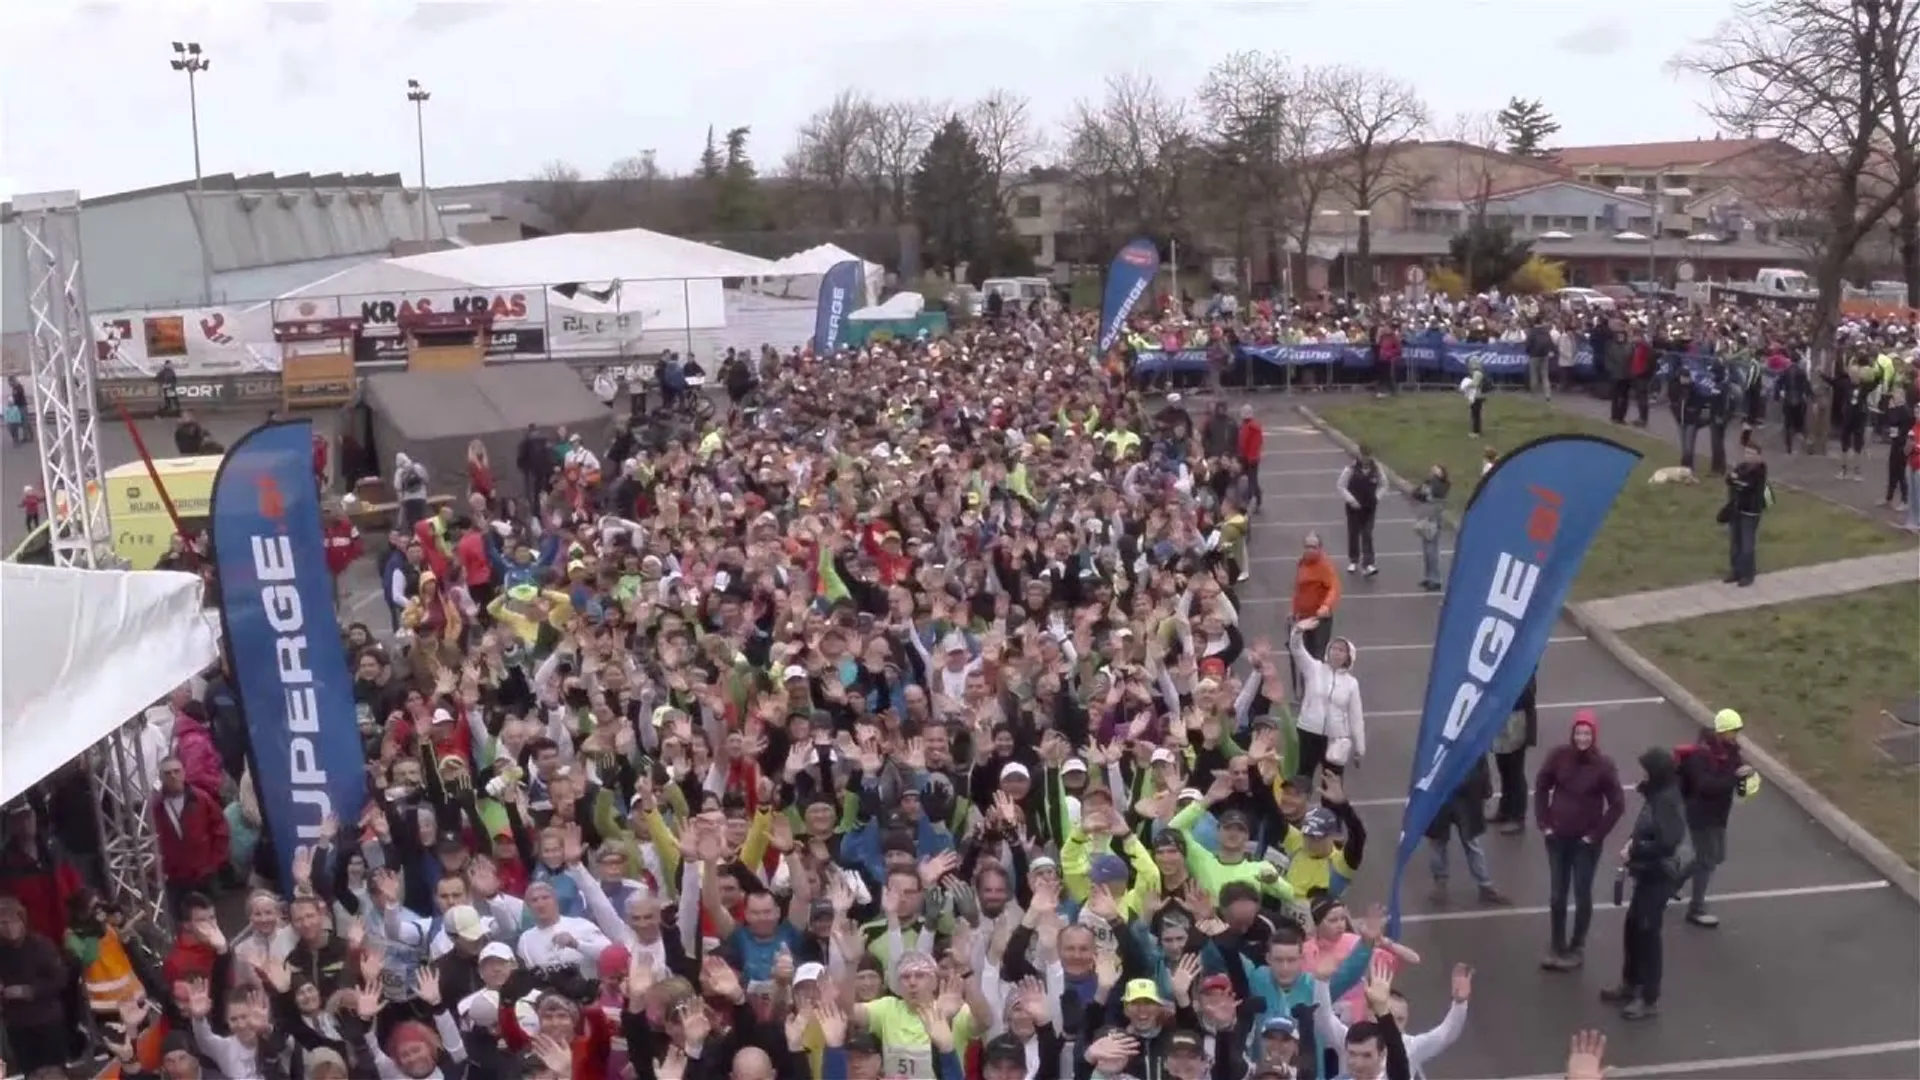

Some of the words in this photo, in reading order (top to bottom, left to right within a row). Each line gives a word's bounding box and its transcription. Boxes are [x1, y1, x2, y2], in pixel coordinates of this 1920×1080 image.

[361, 298, 432, 323] KRAS
[453, 293, 527, 317] KRAS
[898, 1058, 915, 1076] 51
